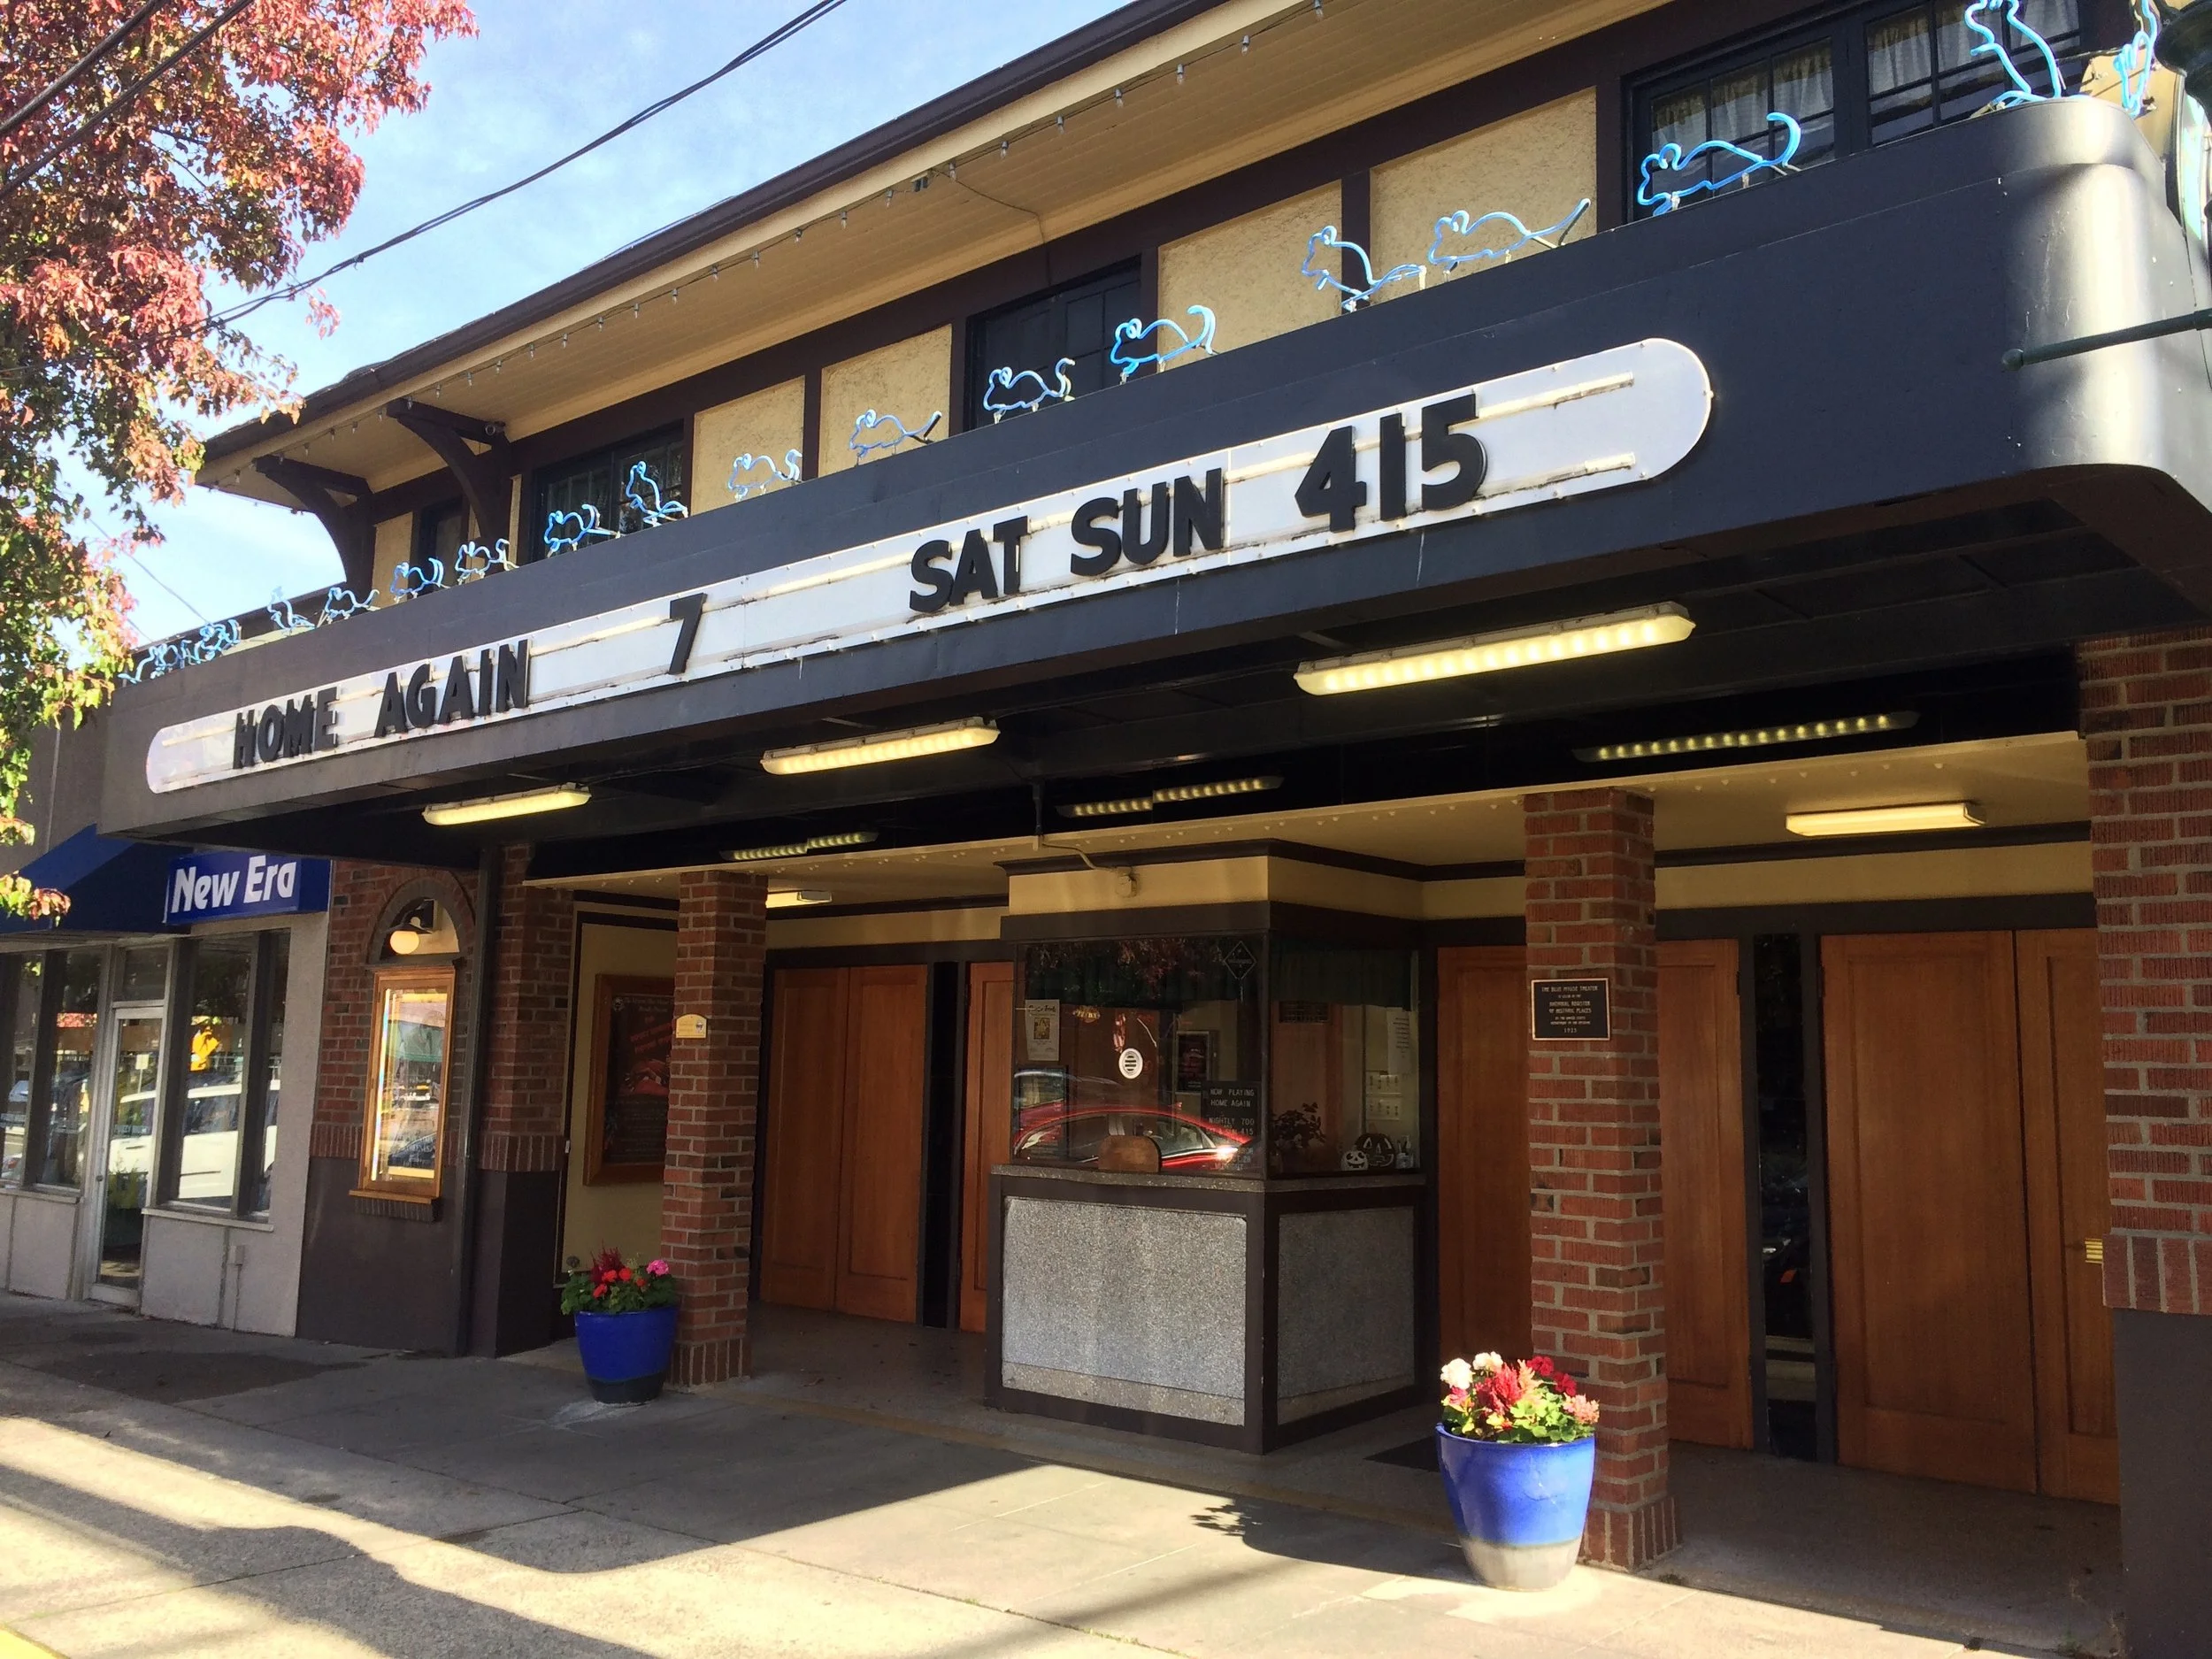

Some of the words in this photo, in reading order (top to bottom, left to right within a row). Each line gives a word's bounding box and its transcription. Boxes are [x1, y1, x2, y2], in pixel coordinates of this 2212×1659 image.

[232, 687, 339, 770] HOME
[374, 639, 532, 739] AGAIN
[667, 592, 708, 675] 7
[909, 515, 1028, 612] SAT
[1071, 468, 1225, 577] SUN
[1294, 393, 1488, 533] 415
[171, 866, 241, 913] New
[243, 855, 297, 903] Era
